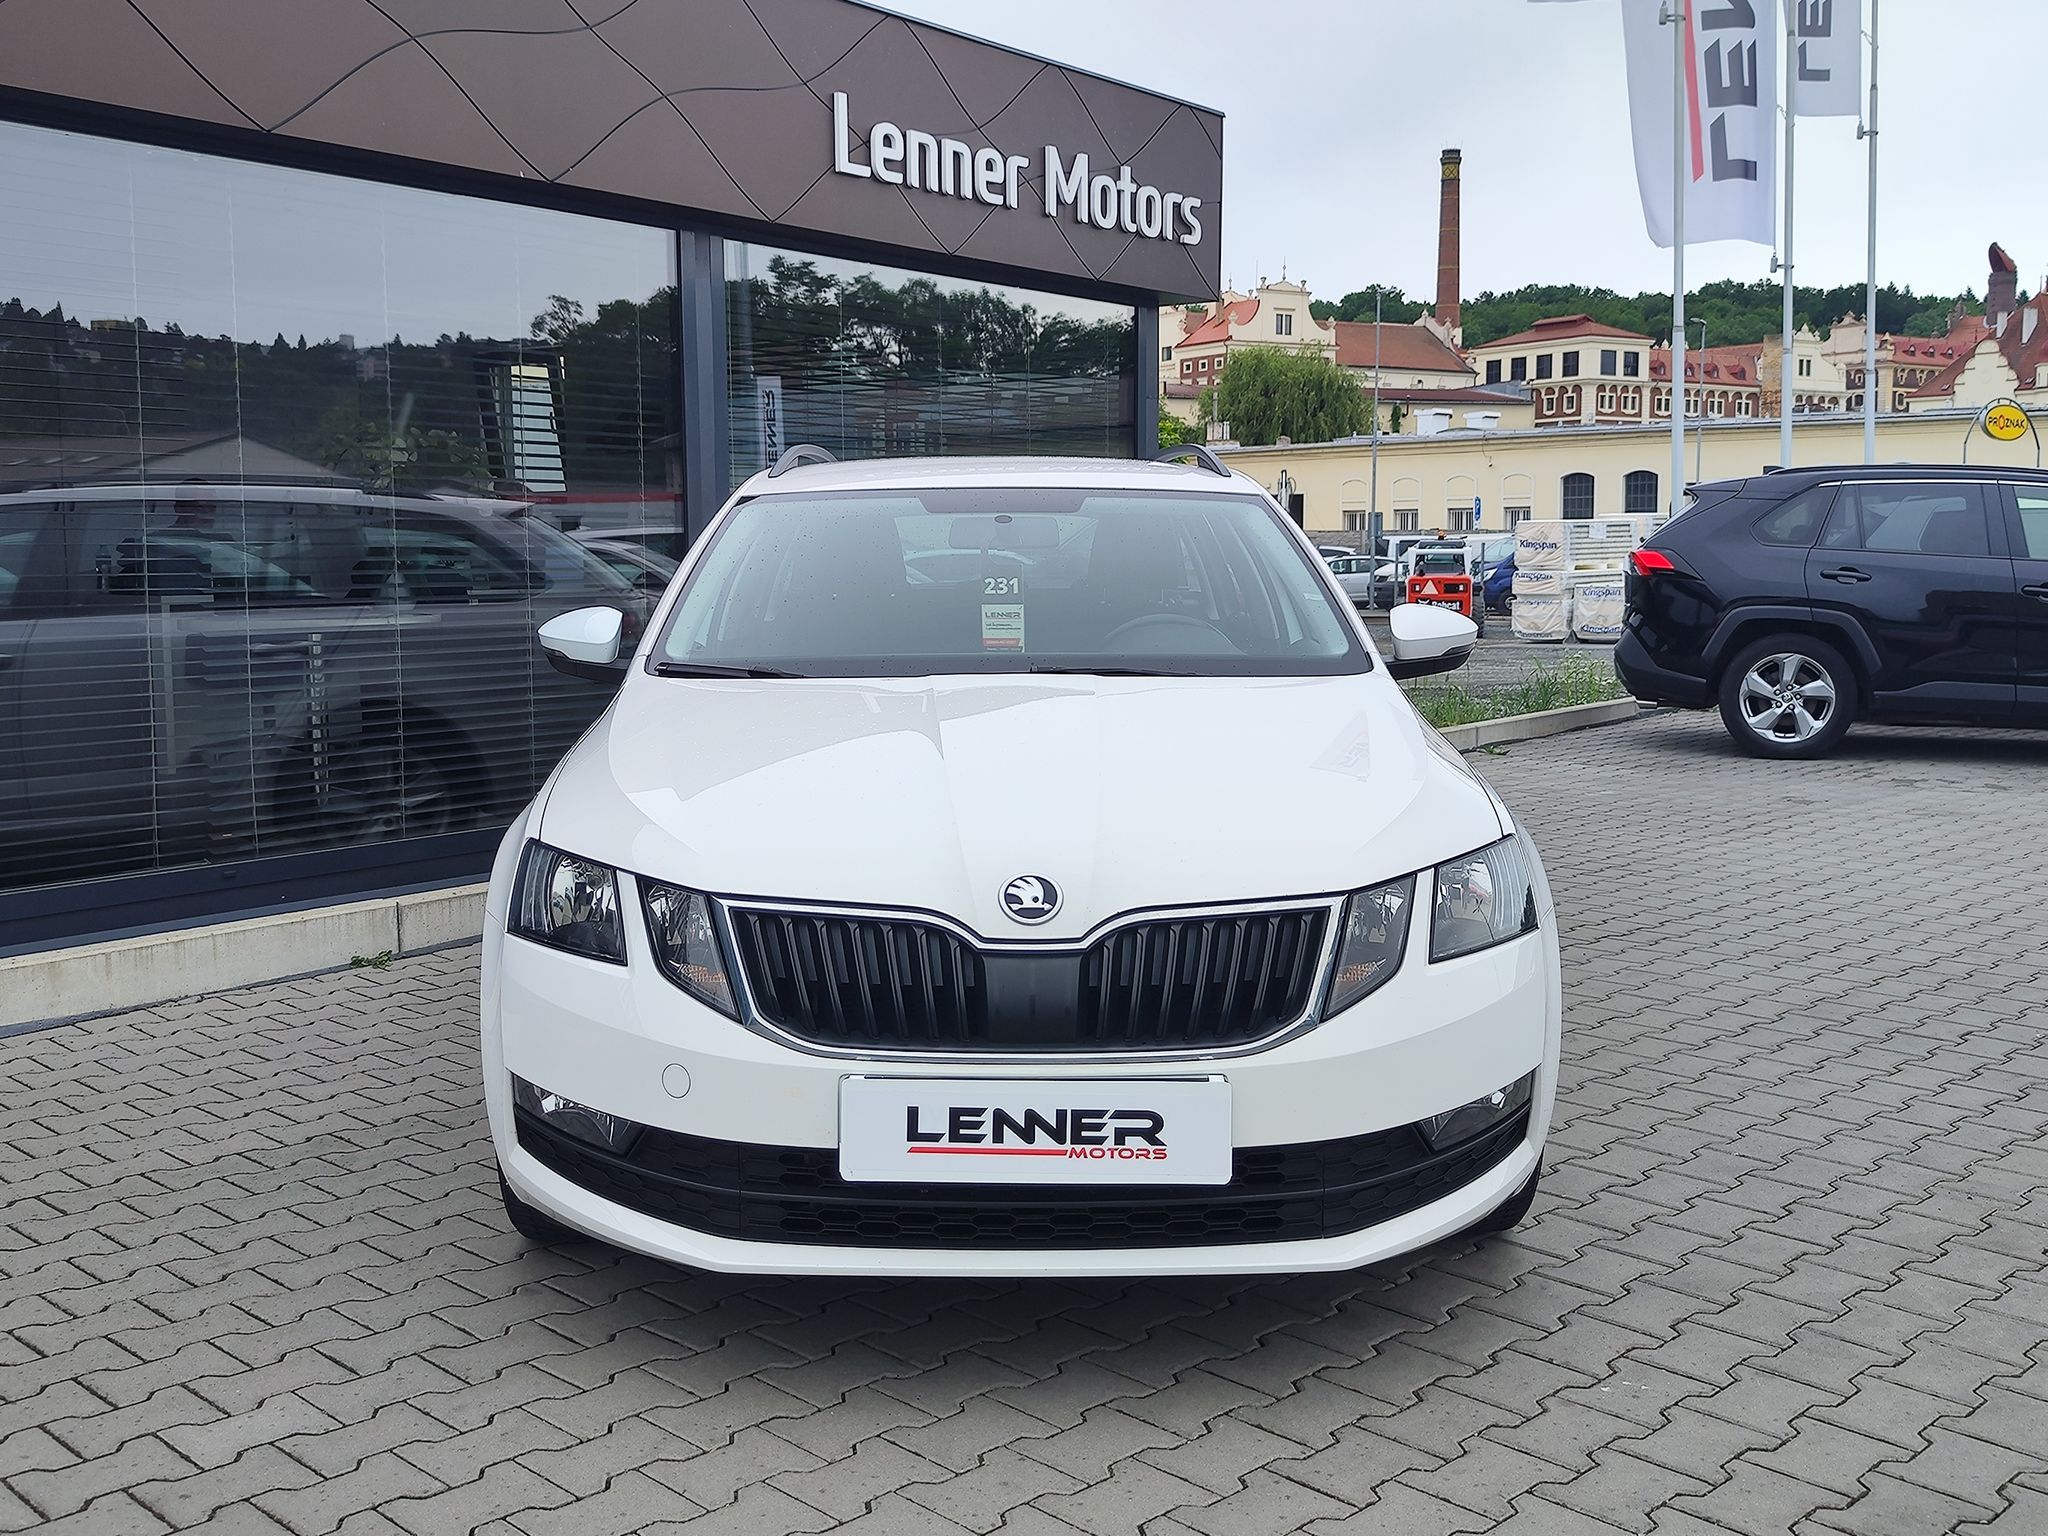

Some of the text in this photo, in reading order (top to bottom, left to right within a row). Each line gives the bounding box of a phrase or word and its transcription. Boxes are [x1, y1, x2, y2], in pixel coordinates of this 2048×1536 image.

[832, 91, 1202, 246] Lenner Motors
[1988, 414, 2025, 430] PROZNAK
[1519, 539, 1557, 551] Kingspan
[984, 577, 1019, 594] 231
[1582, 586, 1621, 598] Kingspan
[906, 1105, 1167, 1146] LENNER
[1068, 1147, 1167, 1160] MOTORS
